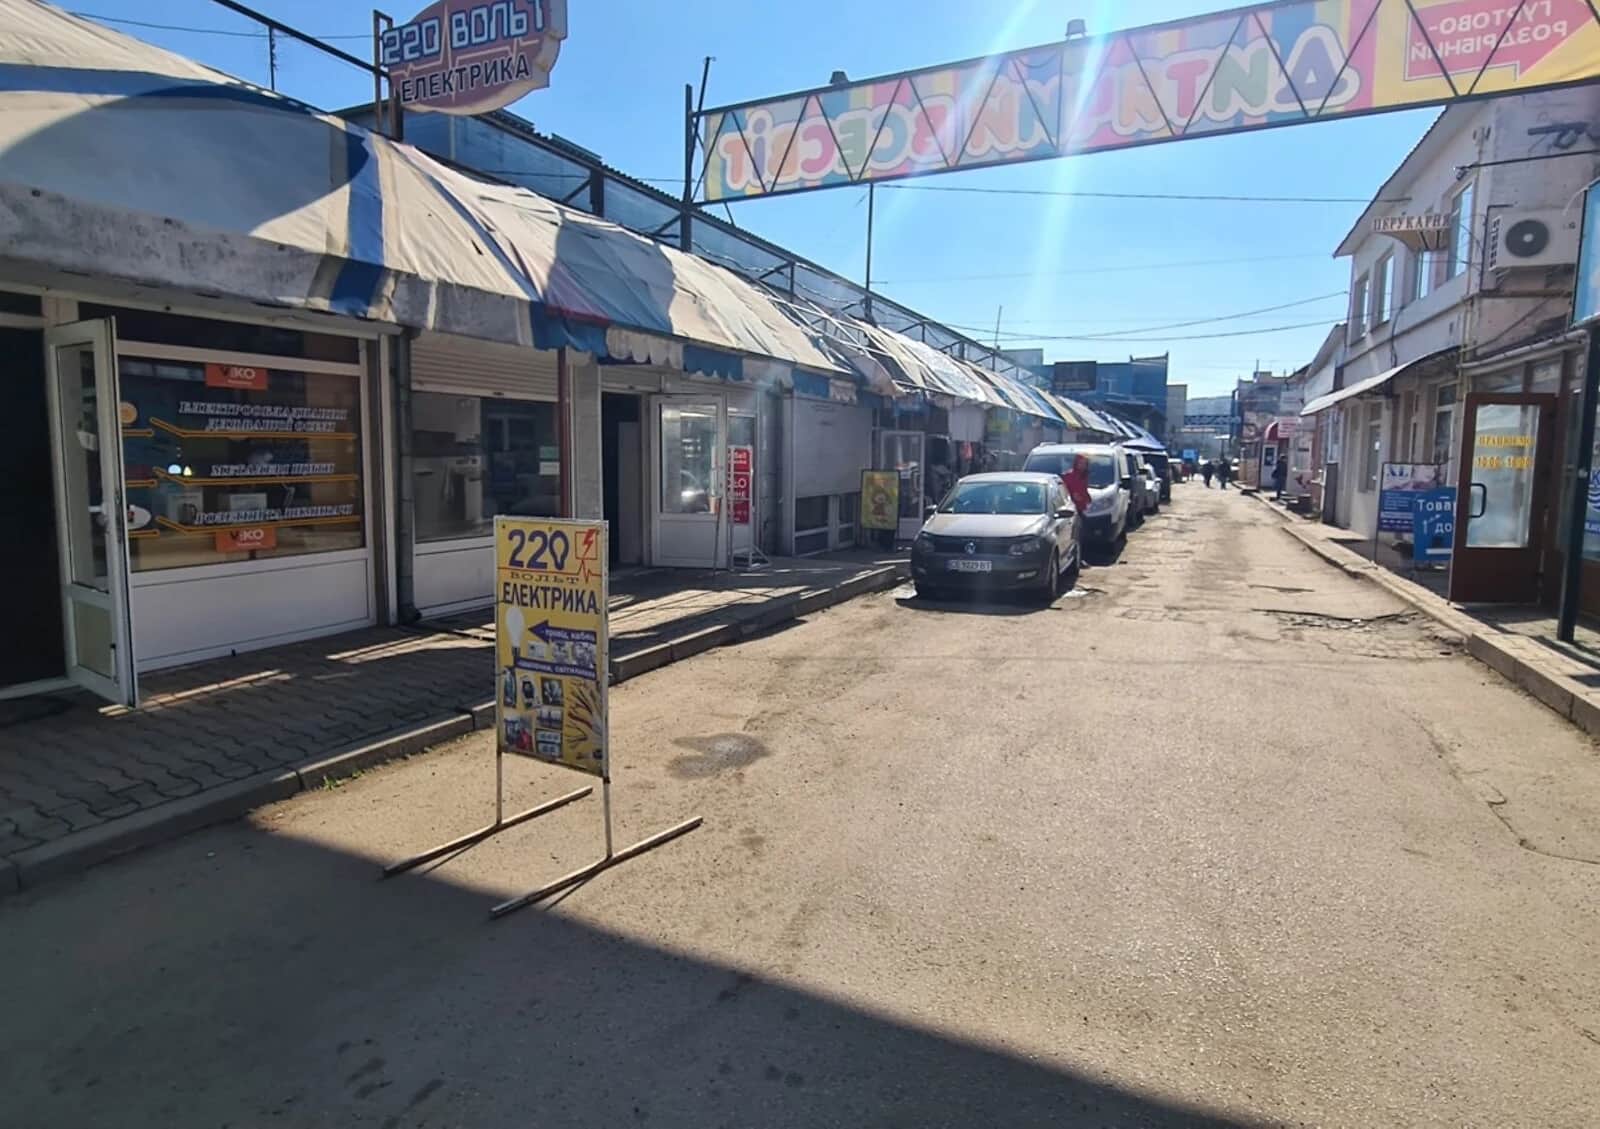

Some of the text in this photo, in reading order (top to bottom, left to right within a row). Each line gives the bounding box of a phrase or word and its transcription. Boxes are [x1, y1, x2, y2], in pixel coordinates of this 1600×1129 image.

[382, 0, 544, 66] 220 ВОЛЬТ
[401, 54, 530, 102] ЕЛЕКТРИКА
[507, 528, 569, 571] 220
[502, 581, 600, 615] ЕЛЕКТРИКА
[510, 571, 580, 585] ВОЛЬТ
